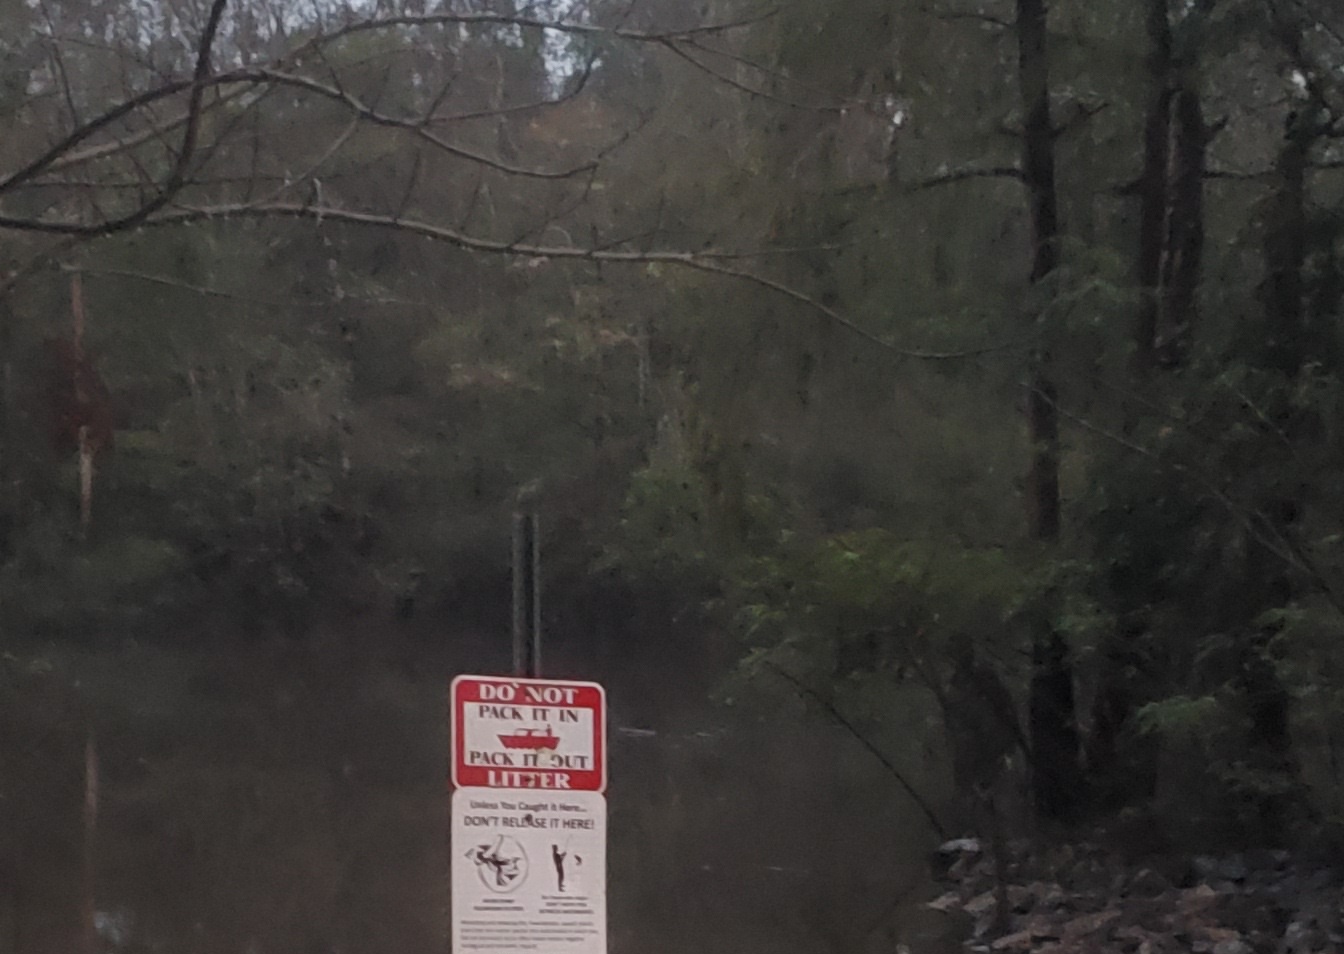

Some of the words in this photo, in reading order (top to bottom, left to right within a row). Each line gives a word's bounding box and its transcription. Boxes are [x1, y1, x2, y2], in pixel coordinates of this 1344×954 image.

[479, 683, 515, 700] DO
[526, 686, 579, 705] NOT
[479, 705, 523, 721] PACK
[532, 707, 550, 721] IT
[559, 709, 579, 723] IN
[469, 750, 513, 766] PACK
[523, 753, 537, 767] IT
[550, 754, 589, 769] OUT
[487, 770, 571, 788] LITTER
[500, 801, 516, 810] You
[518, 802, 548, 812] Caught
[464, 815, 499, 827] DON'T
[502, 816, 547, 828] RELEASE
[550, 818, 560, 829] IT
[562, 818, 595, 829] HERE!
